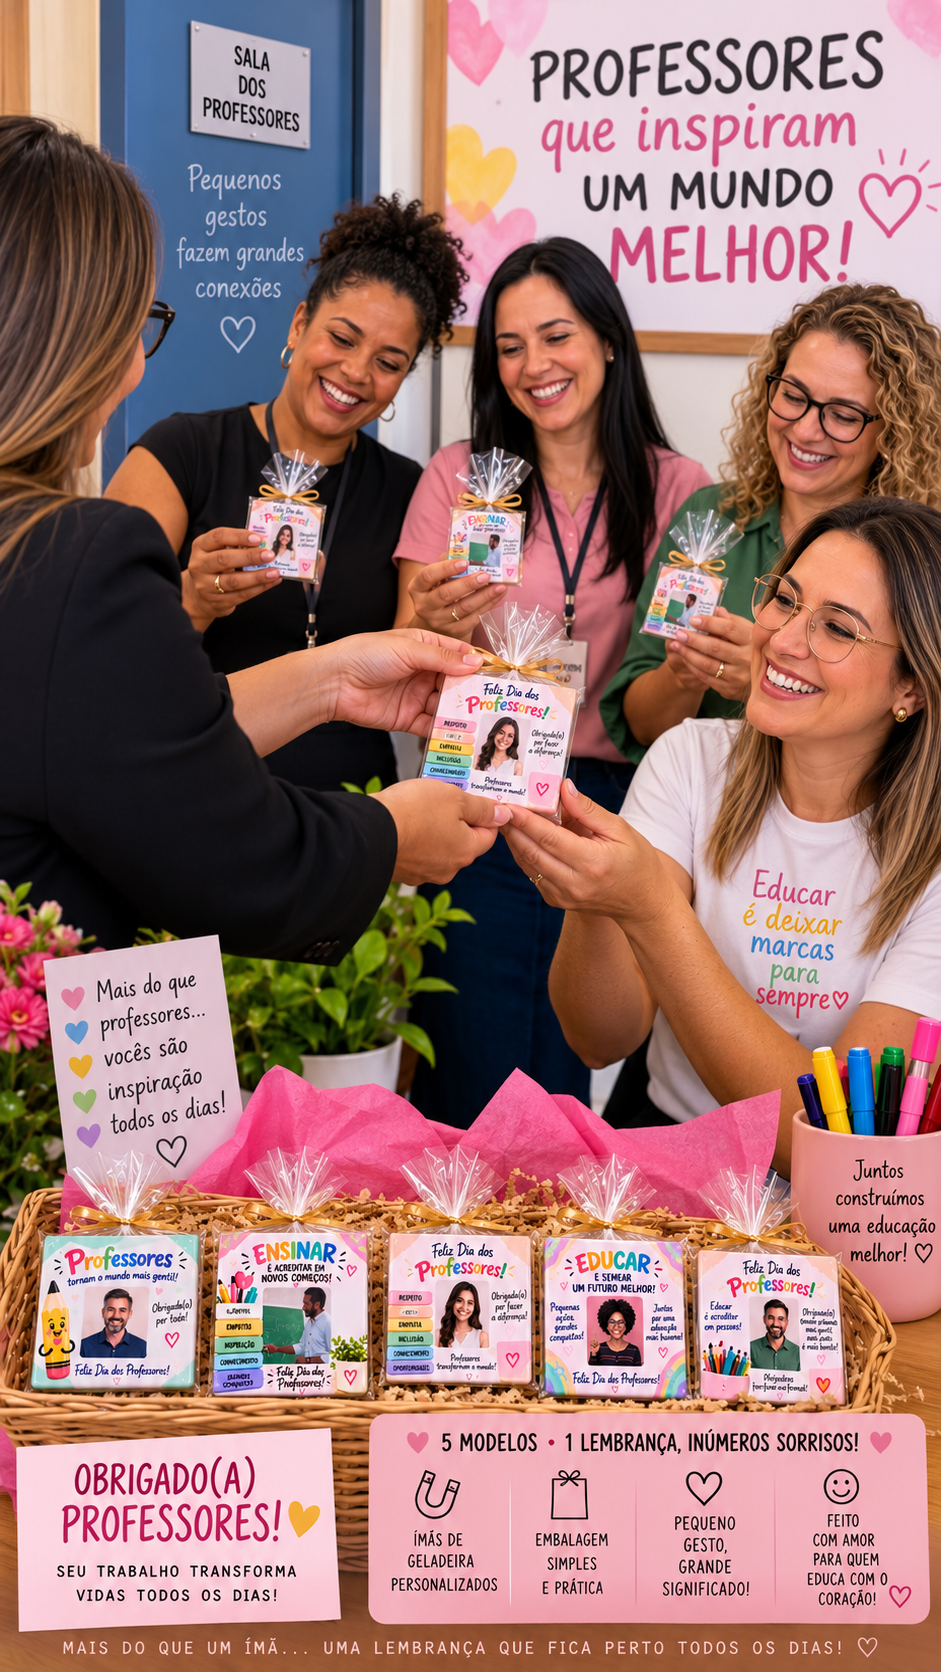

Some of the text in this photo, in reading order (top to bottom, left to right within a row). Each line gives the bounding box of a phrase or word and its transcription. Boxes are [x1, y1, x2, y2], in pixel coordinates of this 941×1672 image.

[234, 46, 270, 72] SALA
[530, 30, 884, 102] PROFESSORES
[238, 75, 266, 98] DOS
[203, 97, 300, 132] PROFESSORES
[541, 102, 856, 173] que inspiram
[187, 164, 282, 200] Pequenos
[584, 168, 833, 212] UM MUNDO
[205, 202, 267, 236] gestos
[177, 237, 304, 271] fazem grandes
[611, 220, 853, 284] MELHOR!
[195, 277, 282, 298] conexões
[484, 683, 540, 700] Feliz Dia dos
[465, 696, 550, 720] Professores!
[752, 869, 836, 906] Educar
[743, 902, 842, 936] é deixar
[750, 936, 834, 961] marcas
[97, 972, 197, 1002] Mais do que
[769, 964, 819, 988] para
[756, 987, 830, 1019] sempre
[100, 1006, 206, 1042] professores...
[104, 1038, 188, 1066] vocês são
[108, 1068, 202, 1105] inspiração
[110, 1090, 226, 1134] todos os dias!
[853, 1159, 904, 1182] Juntos
[836, 1188, 924, 1206] construímos
[828, 1214, 936, 1237] uma educação
[64, 1246, 173, 1275] Professores
[252, 1240, 337, 1265] ENSINAR
[432, 1242, 494, 1258] Feliz Dia dos
[575, 1250, 650, 1274] EDUCAR
[850, 1242, 907, 1263] melhor!
[67, 1276, 96, 1286] tornam
[104, 1270, 130, 1281] mundo
[132, 1271, 150, 1280] mais
[152, 1272, 178, 1284] gentil!
[262, 1274, 288, 1283] NOVOS
[414, 1257, 508, 1282] Professores!
[742, 1260, 800, 1276] Feliz Dia dos
[572, 1284, 656, 1294] UM FUTURO MELHOR!
[726, 1274, 816, 1298] Professores!
[111, 1364, 124, 1375] dos
[74, 1455, 256, 1499] OBRIGADO(A)
[62, 1499, 282, 1544] PROFESSORES!
[56, 1565, 297, 1578] SEU TRABALHO TRANSFORMA
[76, 1589, 278, 1602] VIDAS TODOS OS DIAS!
